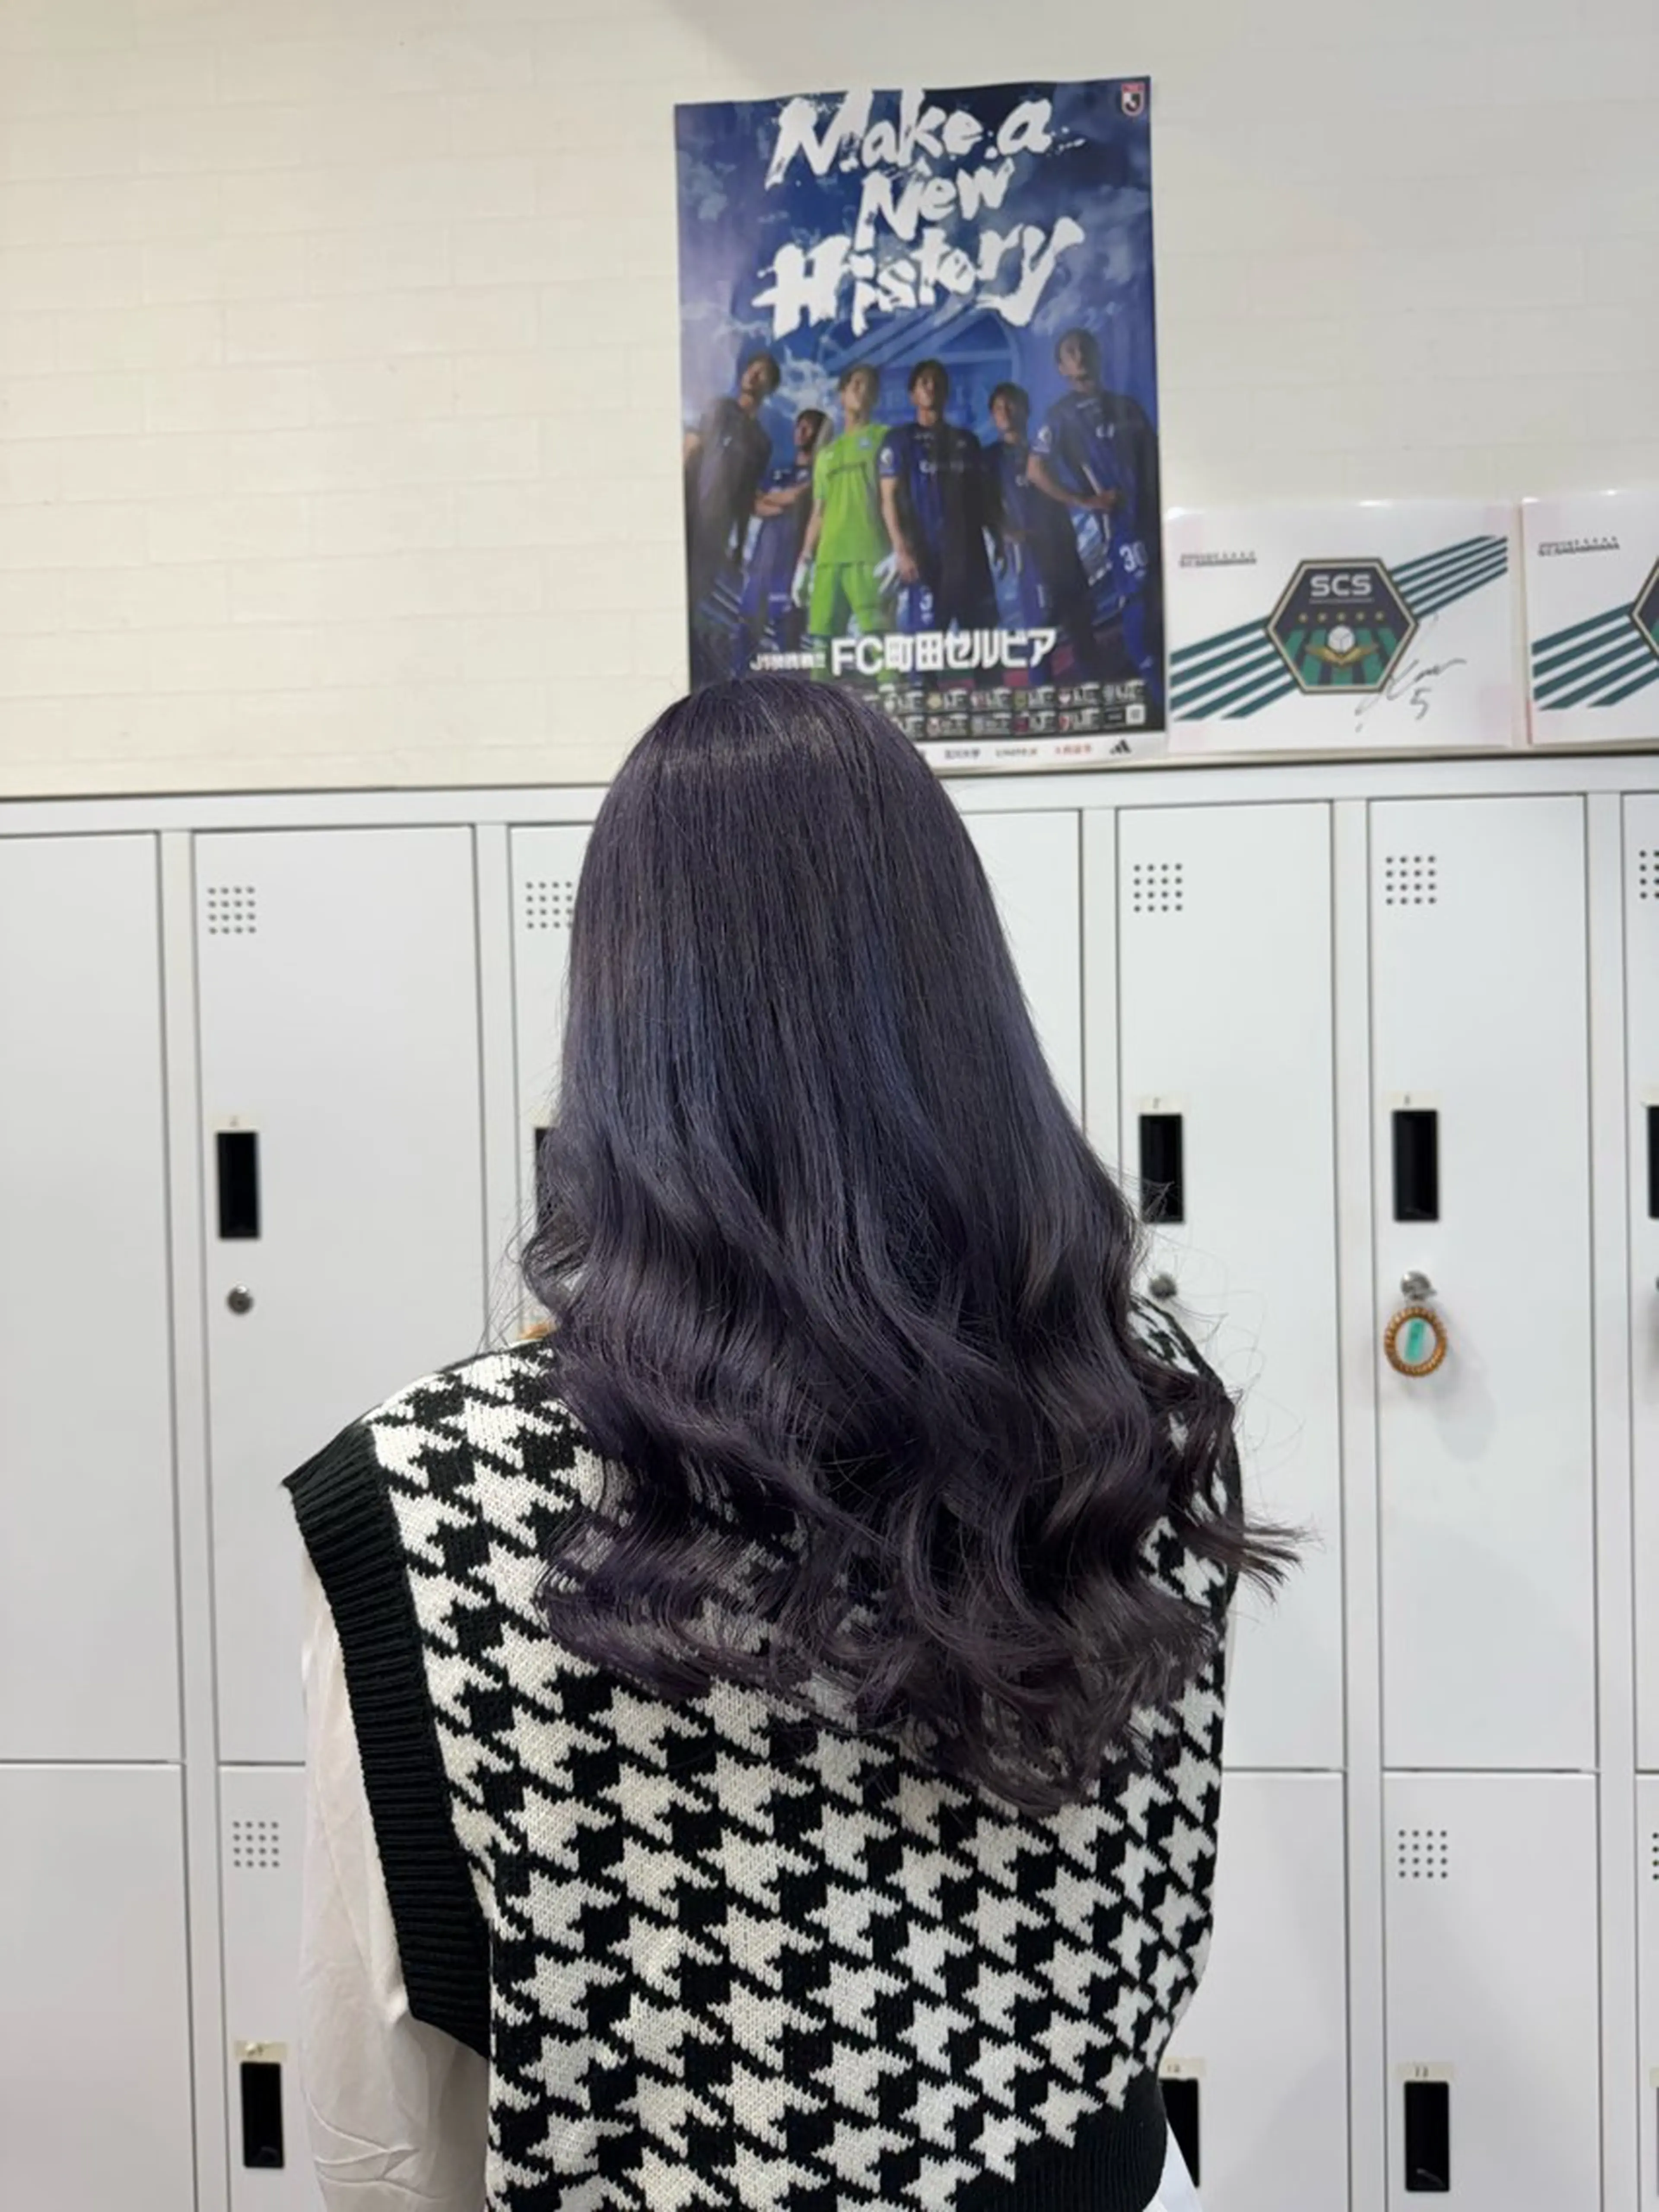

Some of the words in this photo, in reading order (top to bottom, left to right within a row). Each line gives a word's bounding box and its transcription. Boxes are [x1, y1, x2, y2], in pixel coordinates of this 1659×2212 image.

[765, 89, 983, 190] Make
[997, 99, 1052, 154] a
[853, 158, 1015, 250] New
[752, 216, 1085, 340] History
[1310, 574, 1373, 597] SCS
[831, 628, 1057, 677] FC町田ゼルビア
